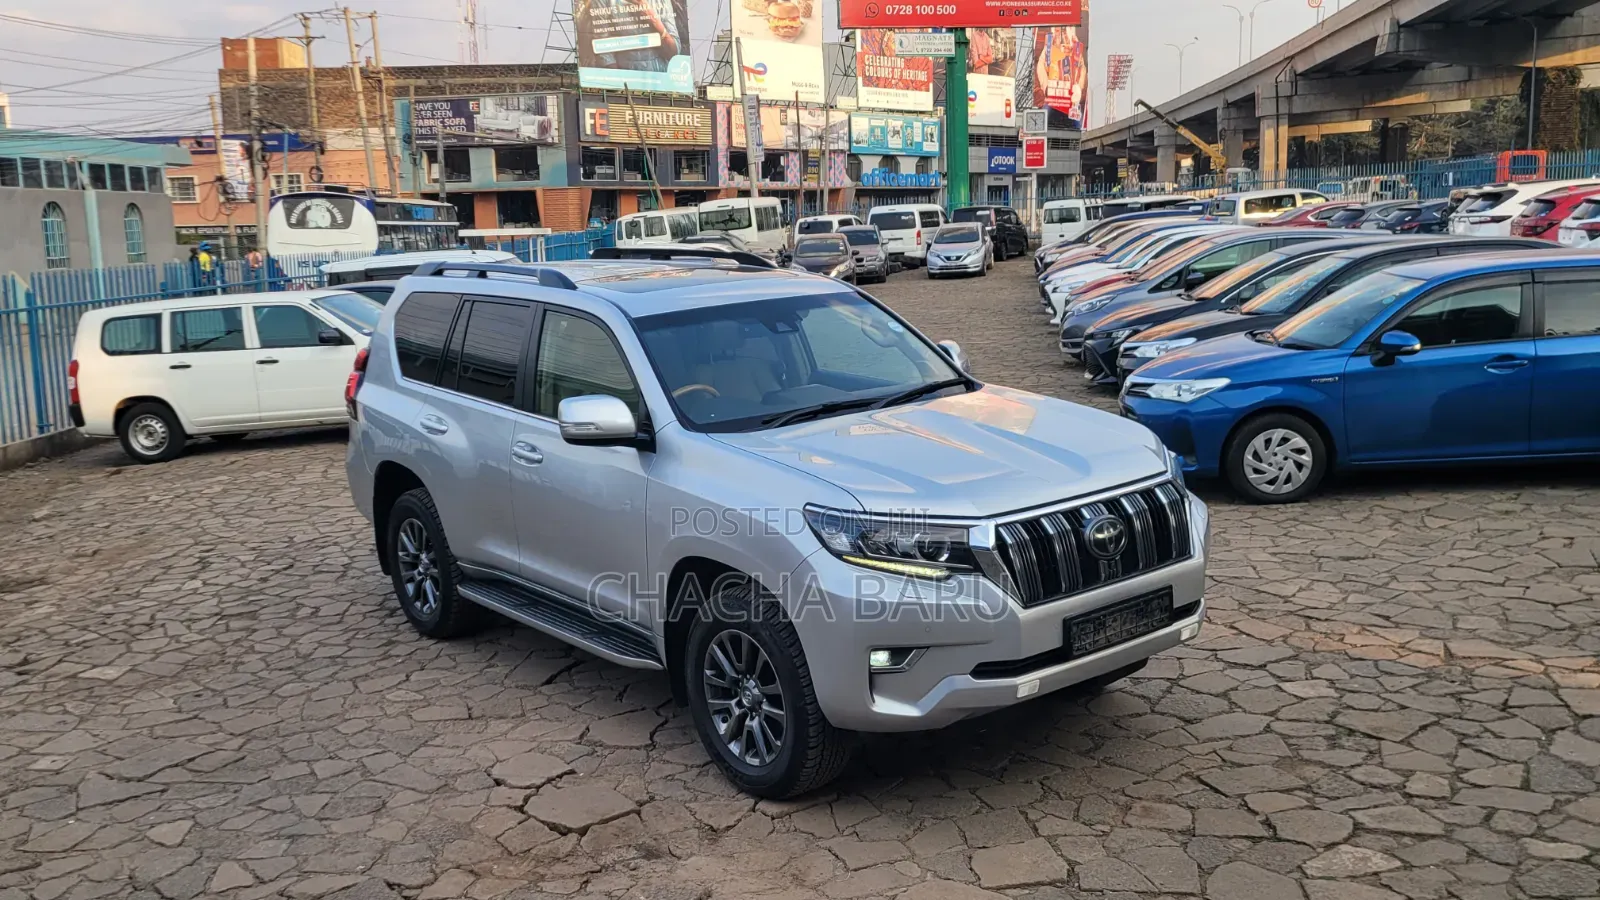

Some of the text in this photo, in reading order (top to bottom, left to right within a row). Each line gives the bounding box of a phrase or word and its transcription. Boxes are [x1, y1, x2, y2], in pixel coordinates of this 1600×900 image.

[589, 6, 618, 17] SHIKU'S
[885, 4, 957, 15] 0728 100 500
[864, 54, 905, 68] CELEBRATING
[865, 65, 928, 81] COLOURS OF HERITAGE
[434, 102, 451, 111] YOU
[469, 101, 480, 111] FE
[433, 110, 453, 118] SEEN
[625, 110, 702, 126] FURNITURE
[414, 117, 467, 127] FABRIC SOFA
[584, 107, 609, 136] FE
[415, 127, 431, 135] THIS
[861, 167, 941, 187] officemart
